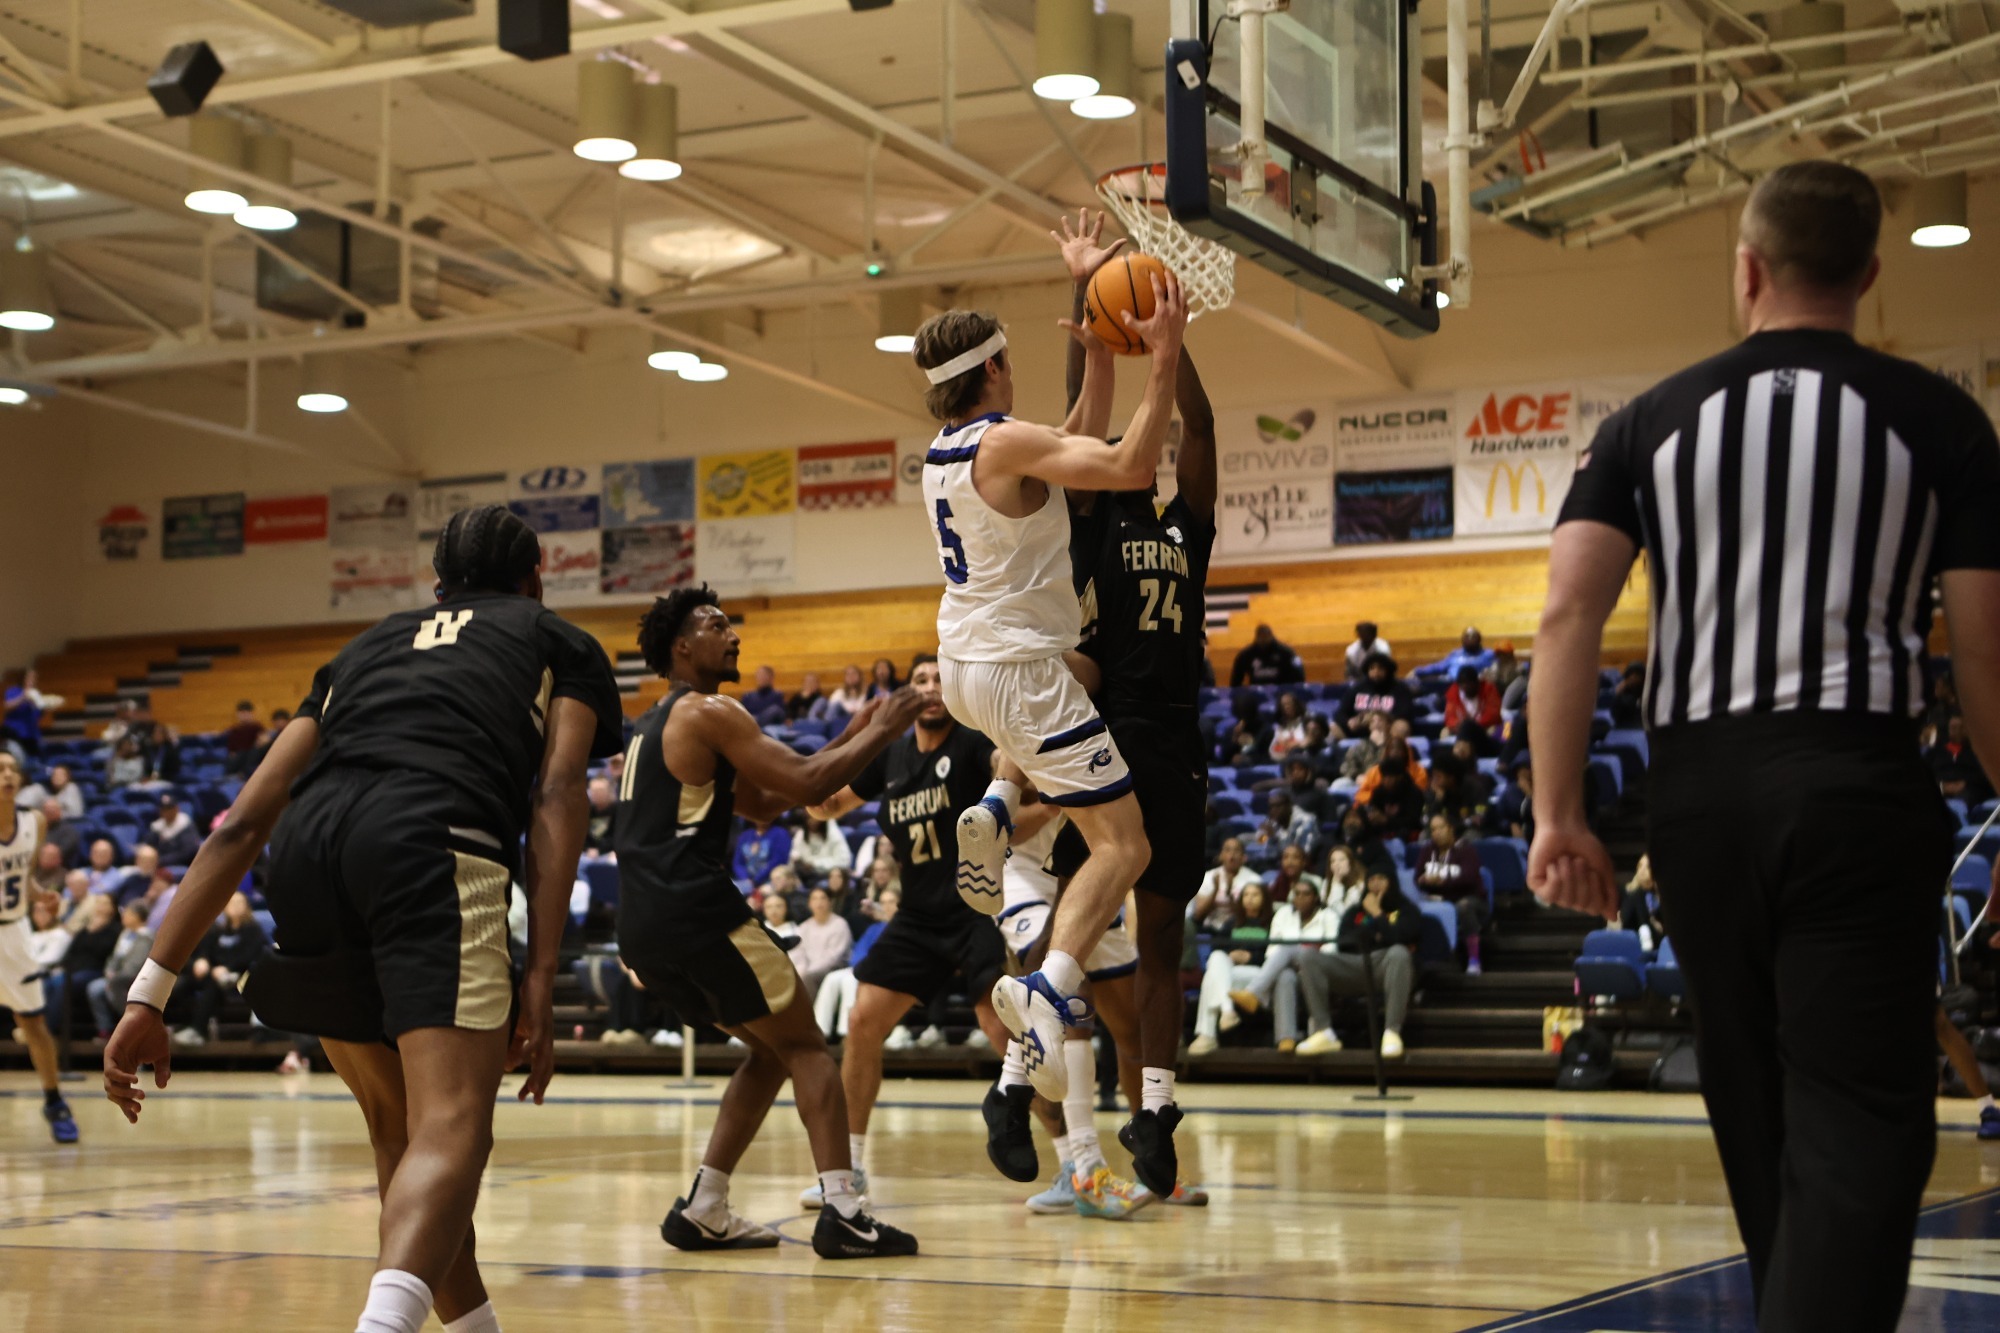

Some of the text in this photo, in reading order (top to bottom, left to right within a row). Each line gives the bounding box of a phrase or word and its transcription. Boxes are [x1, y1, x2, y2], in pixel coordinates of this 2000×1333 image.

[1339, 409, 1447, 430] NUCOR
[1465, 391, 1572, 438] ACE
[1222, 445, 1330, 474] enviva
[1470, 434, 1569, 454] Hardware
[935, 498, 969, 584] 5
[1138, 578, 1183, 634] 24
[620, 733, 644, 801] 11
[908, 819, 942, 865] 21
